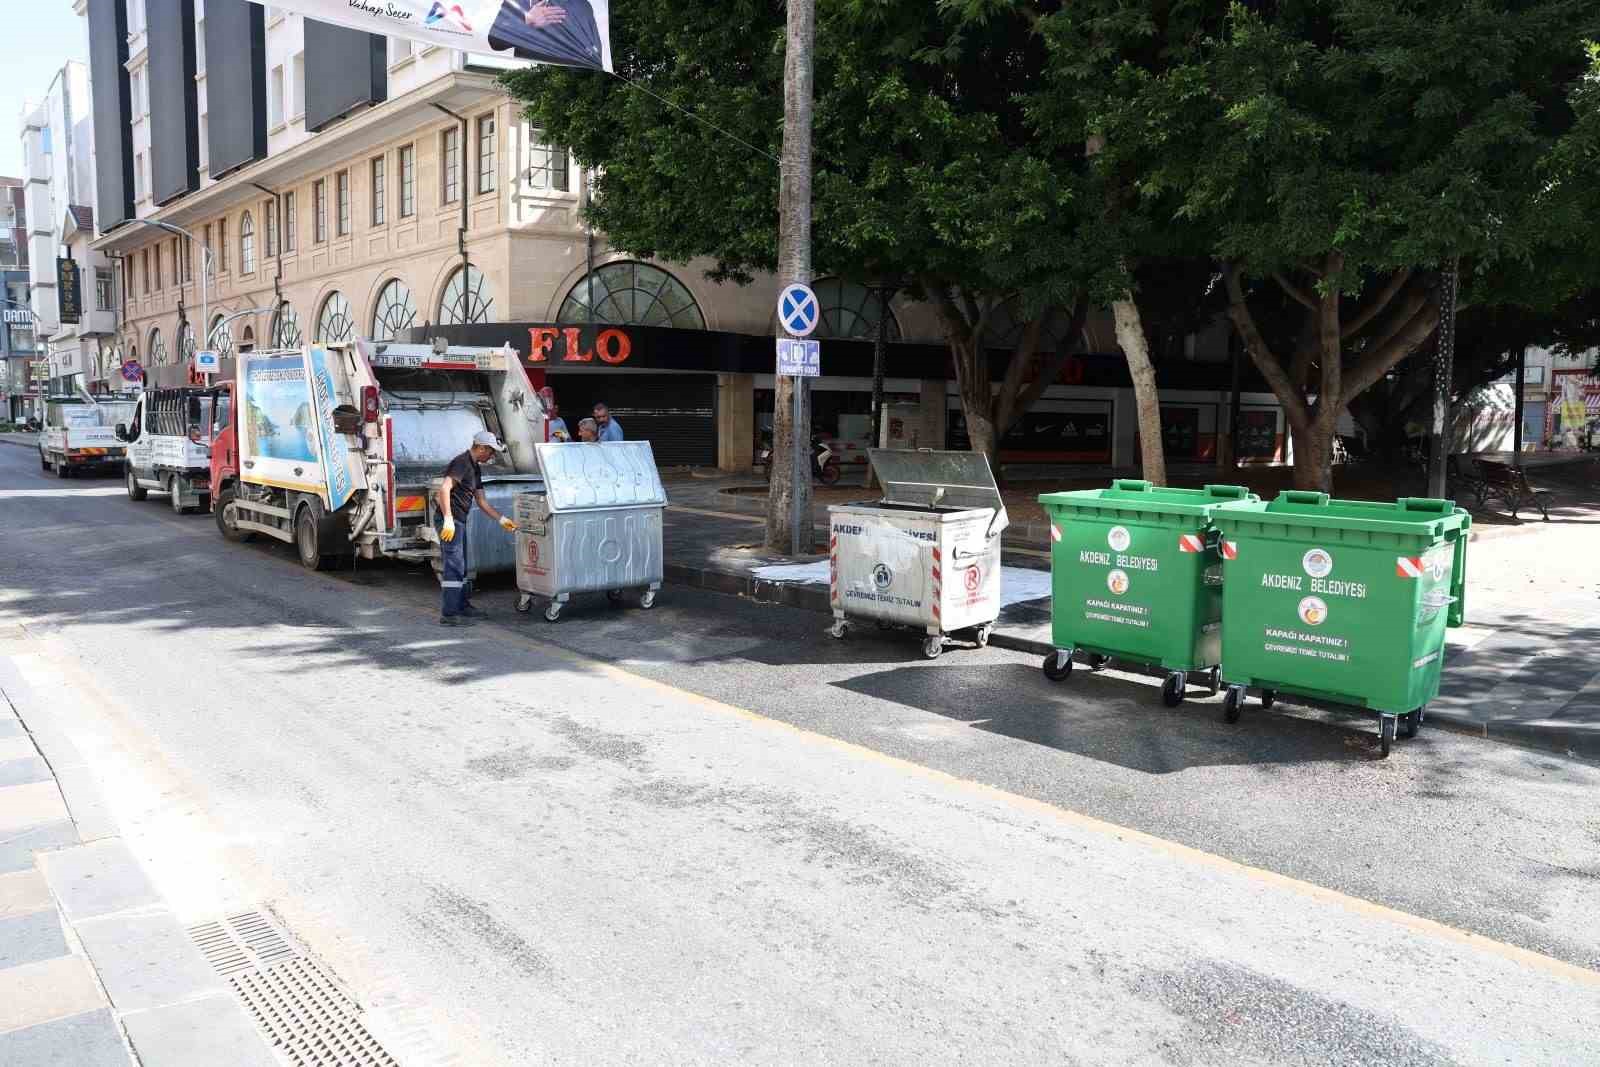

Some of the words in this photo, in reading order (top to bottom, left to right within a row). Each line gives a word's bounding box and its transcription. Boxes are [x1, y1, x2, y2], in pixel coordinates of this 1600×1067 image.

[528, 327, 631, 364] FLO
[1262, 573, 1303, 591] AKDENİZ
[1311, 578, 1366, 598] BELEDİYESİ
[1299, 633, 1344, 647] KAPATINIZ
